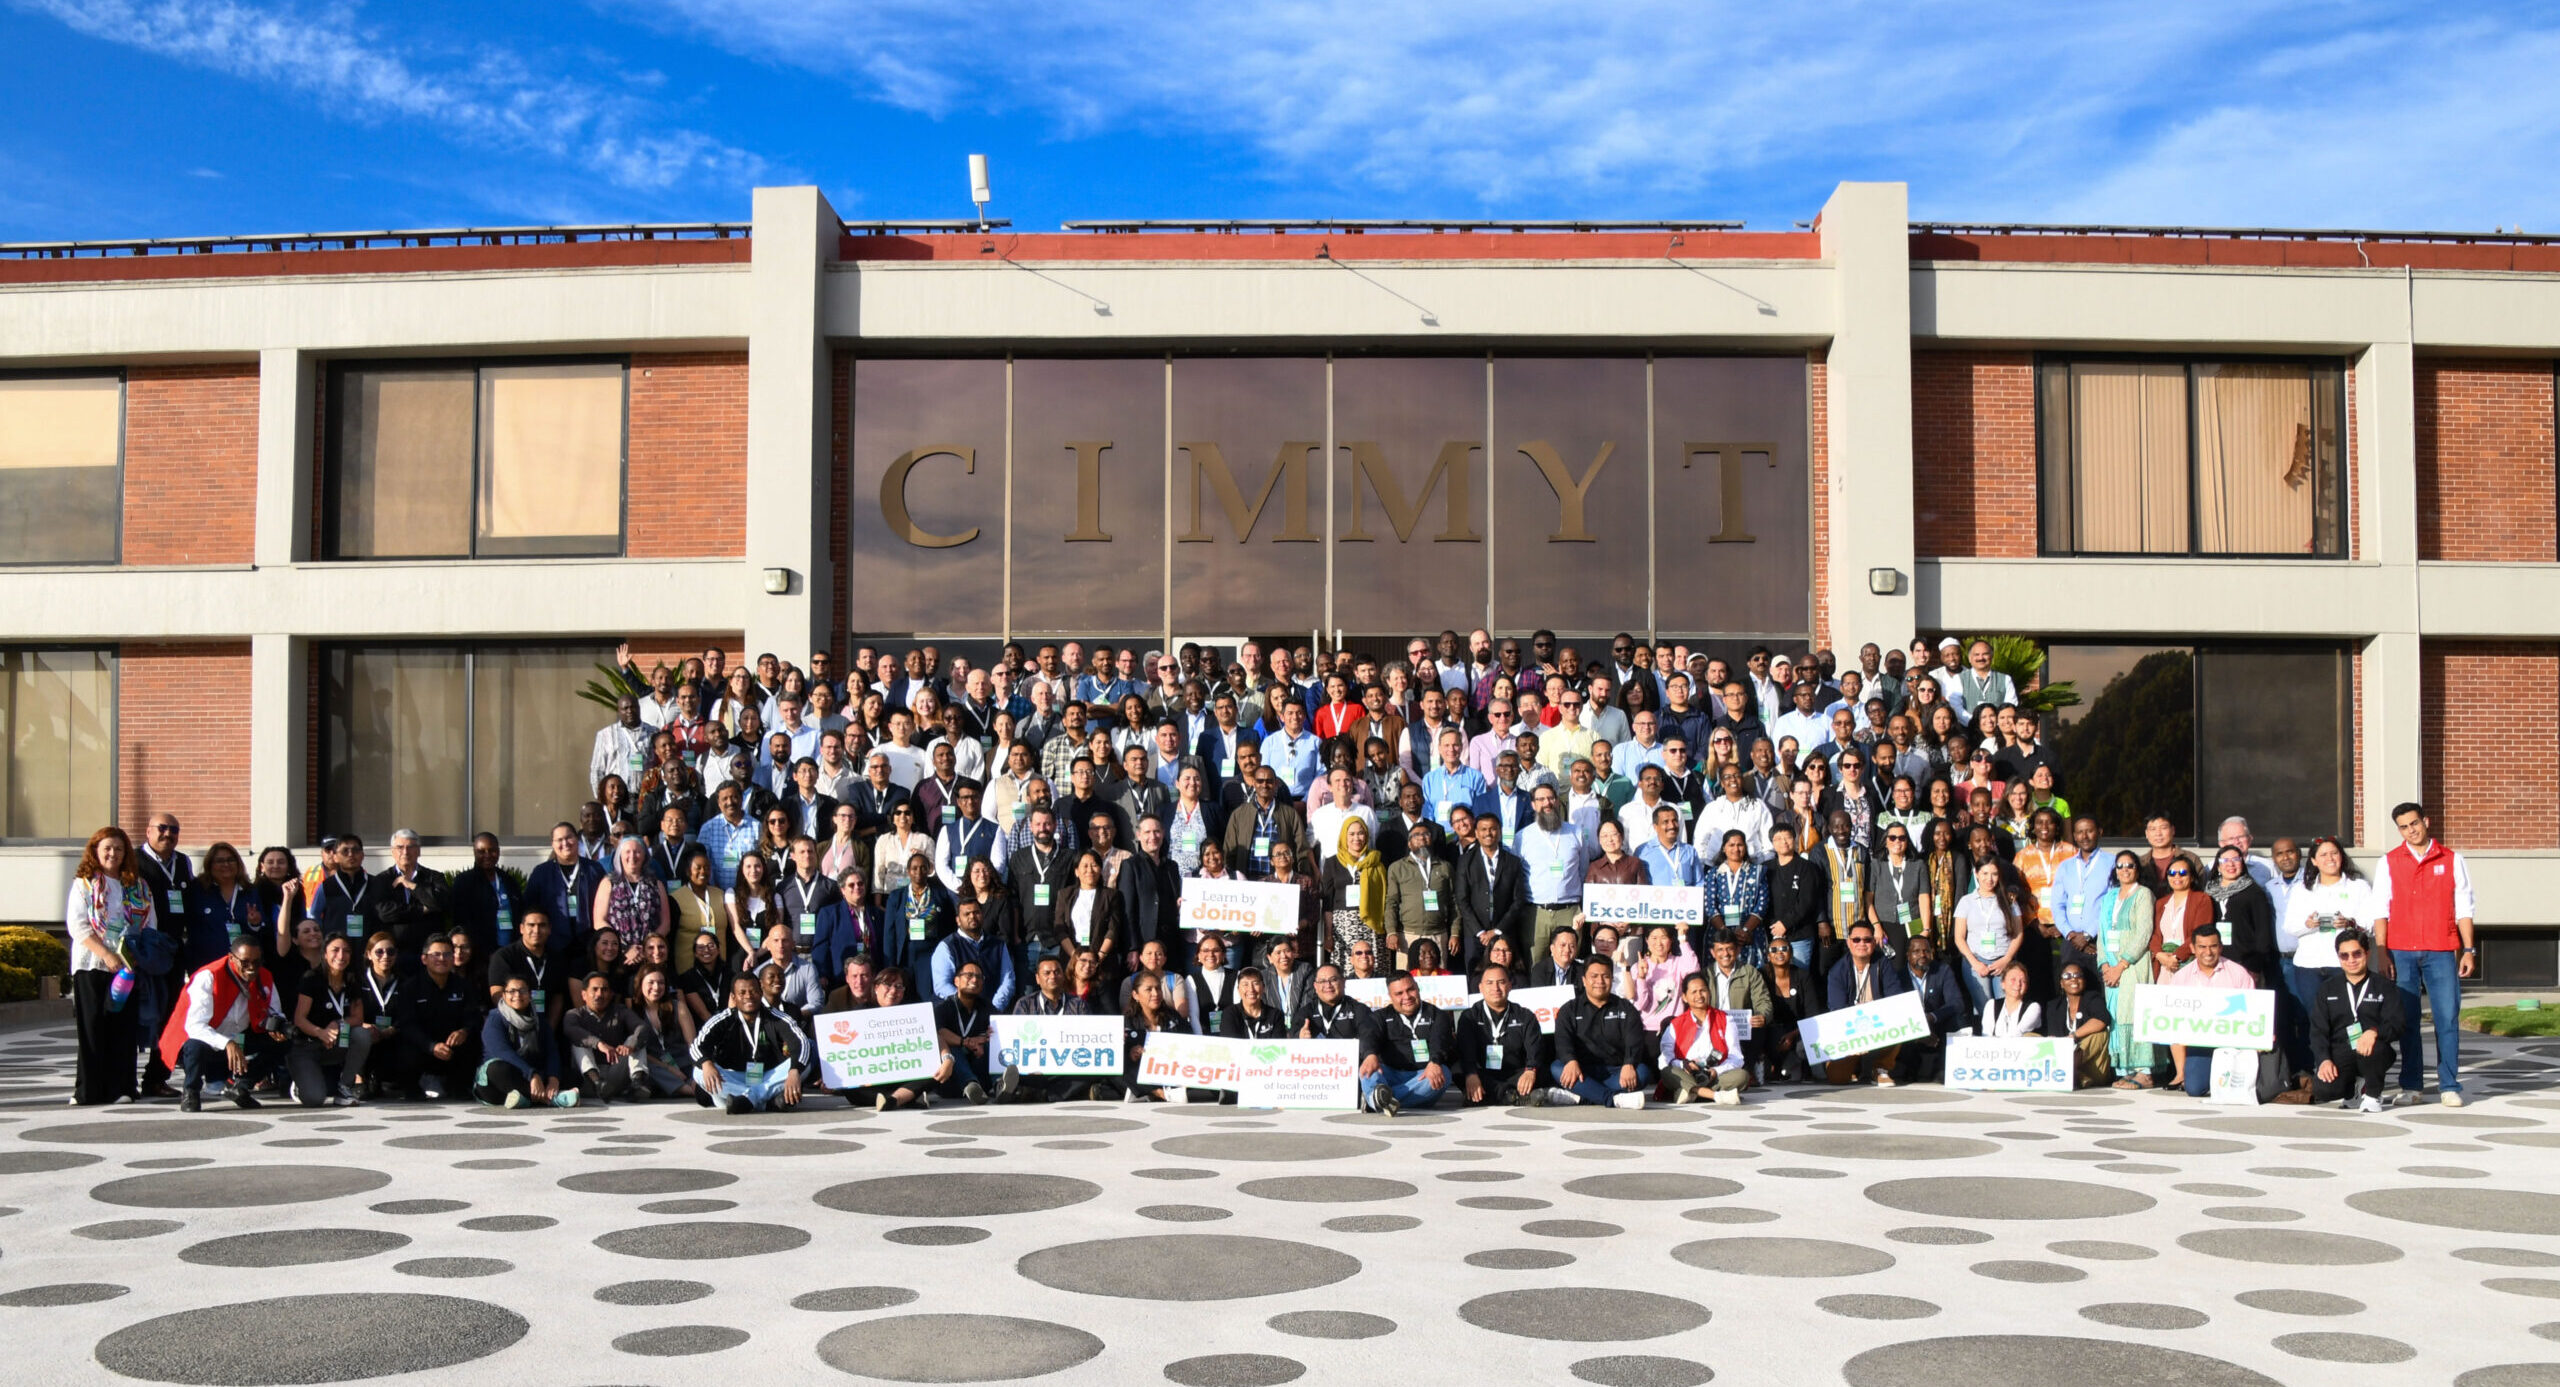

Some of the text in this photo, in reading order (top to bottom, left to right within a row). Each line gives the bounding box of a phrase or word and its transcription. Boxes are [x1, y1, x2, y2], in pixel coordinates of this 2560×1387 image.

[879, 439, 1778, 549] CIMMYT
[1202, 890, 1257, 906] Learn by
[1192, 902, 1256, 928] doing
[1590, 901, 1698, 920] Excellence
[1357, 993, 1465, 1009] ollaative
[2163, 994, 2203, 1012] Leap
[868, 1016, 918, 1029] Generous
[2142, 1007, 2266, 1037] forward
[864, 1025, 925, 1041] in spirit and
[1060, 1030, 1113, 1046] Impact
[1810, 1017, 1923, 1059] Teamwork
[826, 1036, 933, 1062] accountable
[998, 1038, 1115, 1067] driven
[1965, 1047, 2022, 1061] Leap by
[847, 1056, 922, 1076] in action
[1291, 1053, 1348, 1065] Humble
[1146, 1057, 1241, 1085] Integri
[1245, 1065, 1353, 1080] and respectful
[1953, 1059, 2066, 1087] example
[1264, 1082, 1340, 1090] of local context
[1277, 1092, 1329, 1100] and needs
